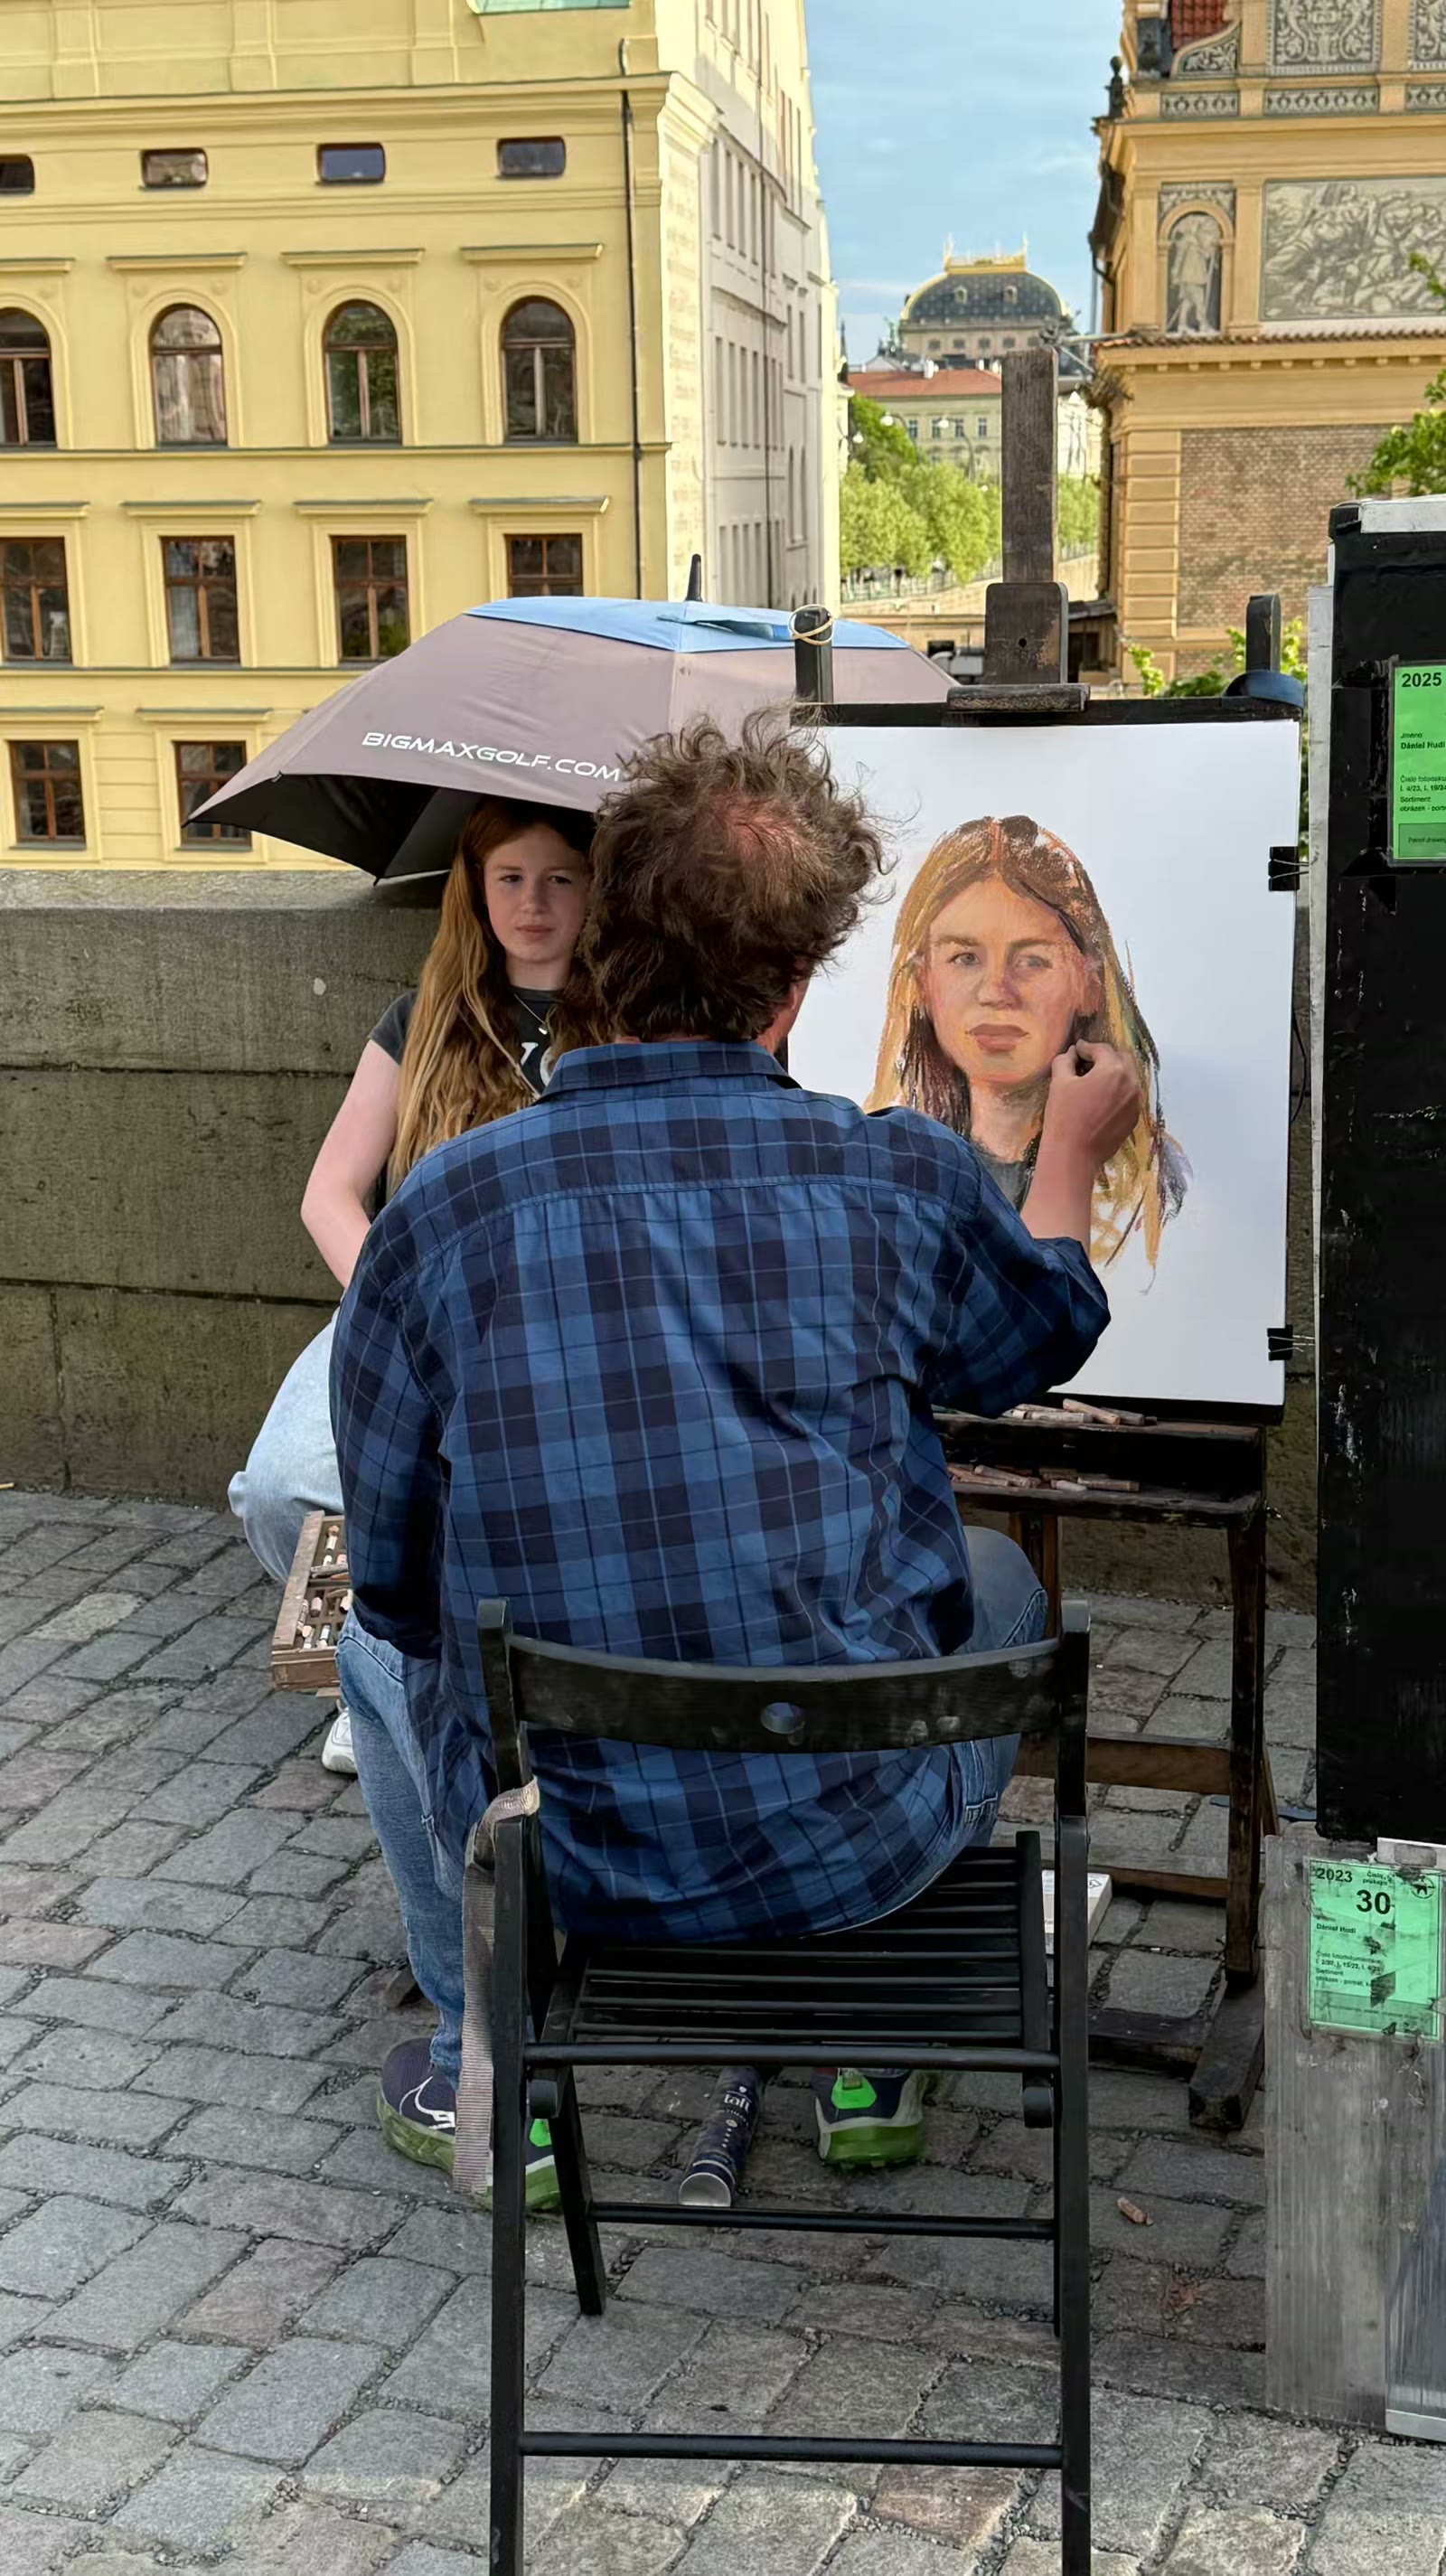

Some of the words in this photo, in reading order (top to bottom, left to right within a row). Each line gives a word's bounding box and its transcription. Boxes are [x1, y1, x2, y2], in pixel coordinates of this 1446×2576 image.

[1402, 672, 1442, 687] 2025
[362, 731, 622, 782] BIGMAXGOLF.COM
[1316, 1867, 1353, 1883] 2023
[1356, 1888, 1391, 1915] 30
